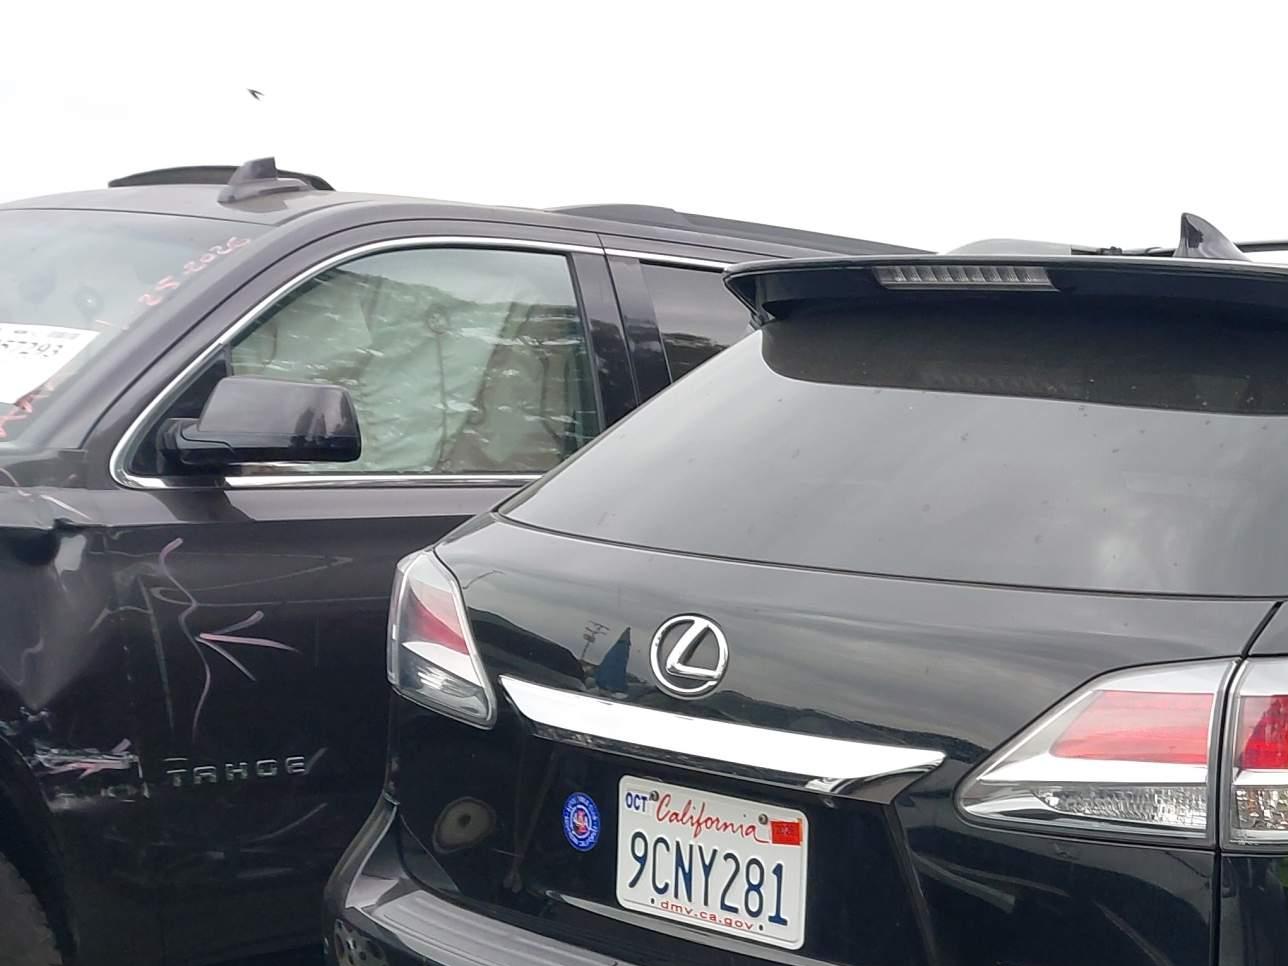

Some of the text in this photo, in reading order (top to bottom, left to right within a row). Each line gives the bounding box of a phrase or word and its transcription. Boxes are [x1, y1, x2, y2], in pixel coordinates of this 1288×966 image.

[162, 755, 306, 787] TAHOE
[625, 791, 648, 813] OCT
[655, 793, 770, 844] California
[628, 830, 789, 927] 9CNY281
[659, 899, 754, 931] dmv.ca.gov
